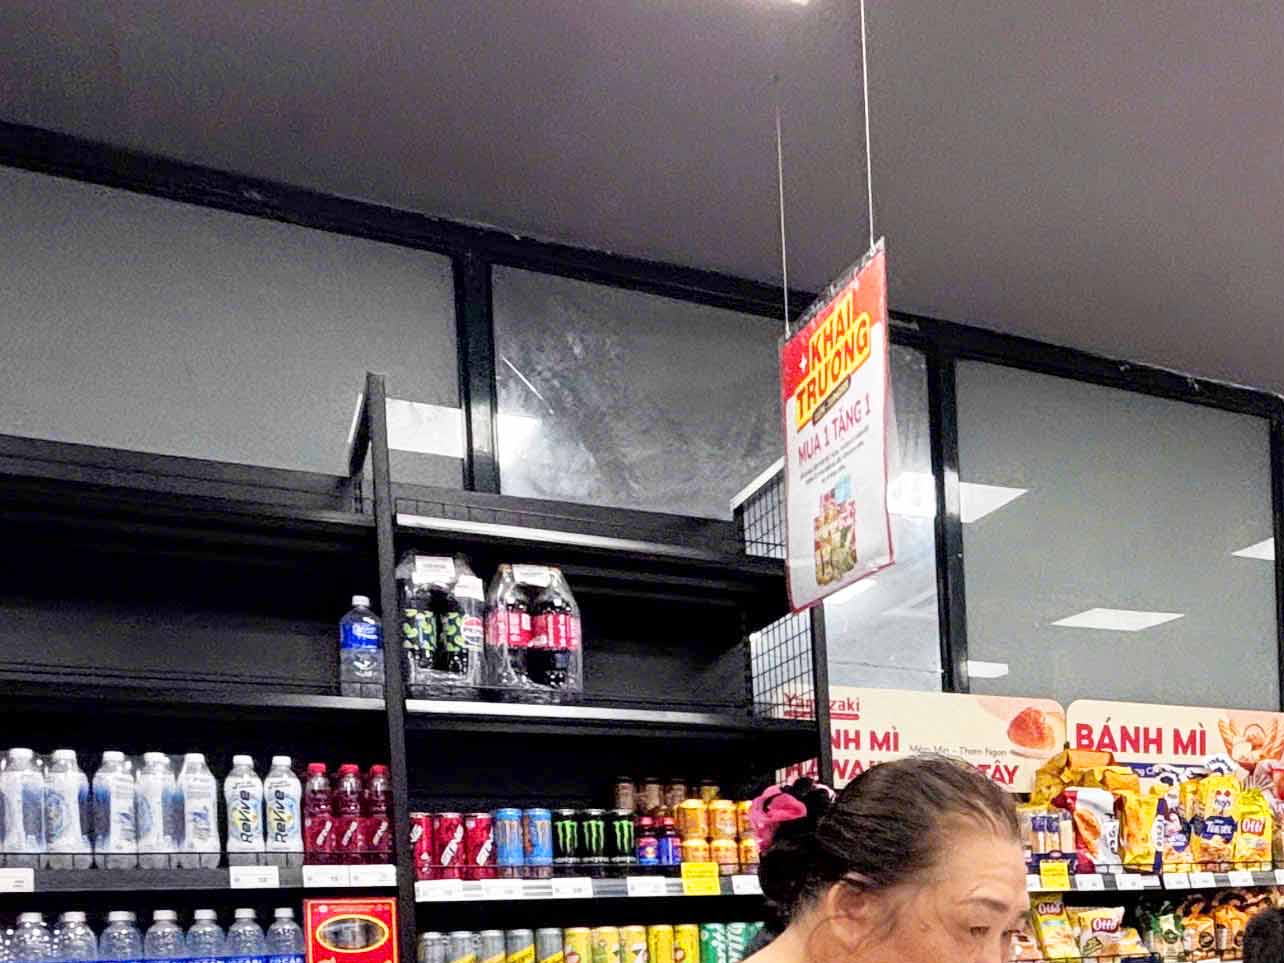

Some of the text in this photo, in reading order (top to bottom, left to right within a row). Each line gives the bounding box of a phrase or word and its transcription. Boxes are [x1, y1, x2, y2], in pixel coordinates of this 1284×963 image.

[811, 299, 853, 369] KHAI
[798, 434, 821, 463] MUA
[870, 726, 900, 752] MÌ
[1076, 717, 1206, 756] BÁNH MÌ
